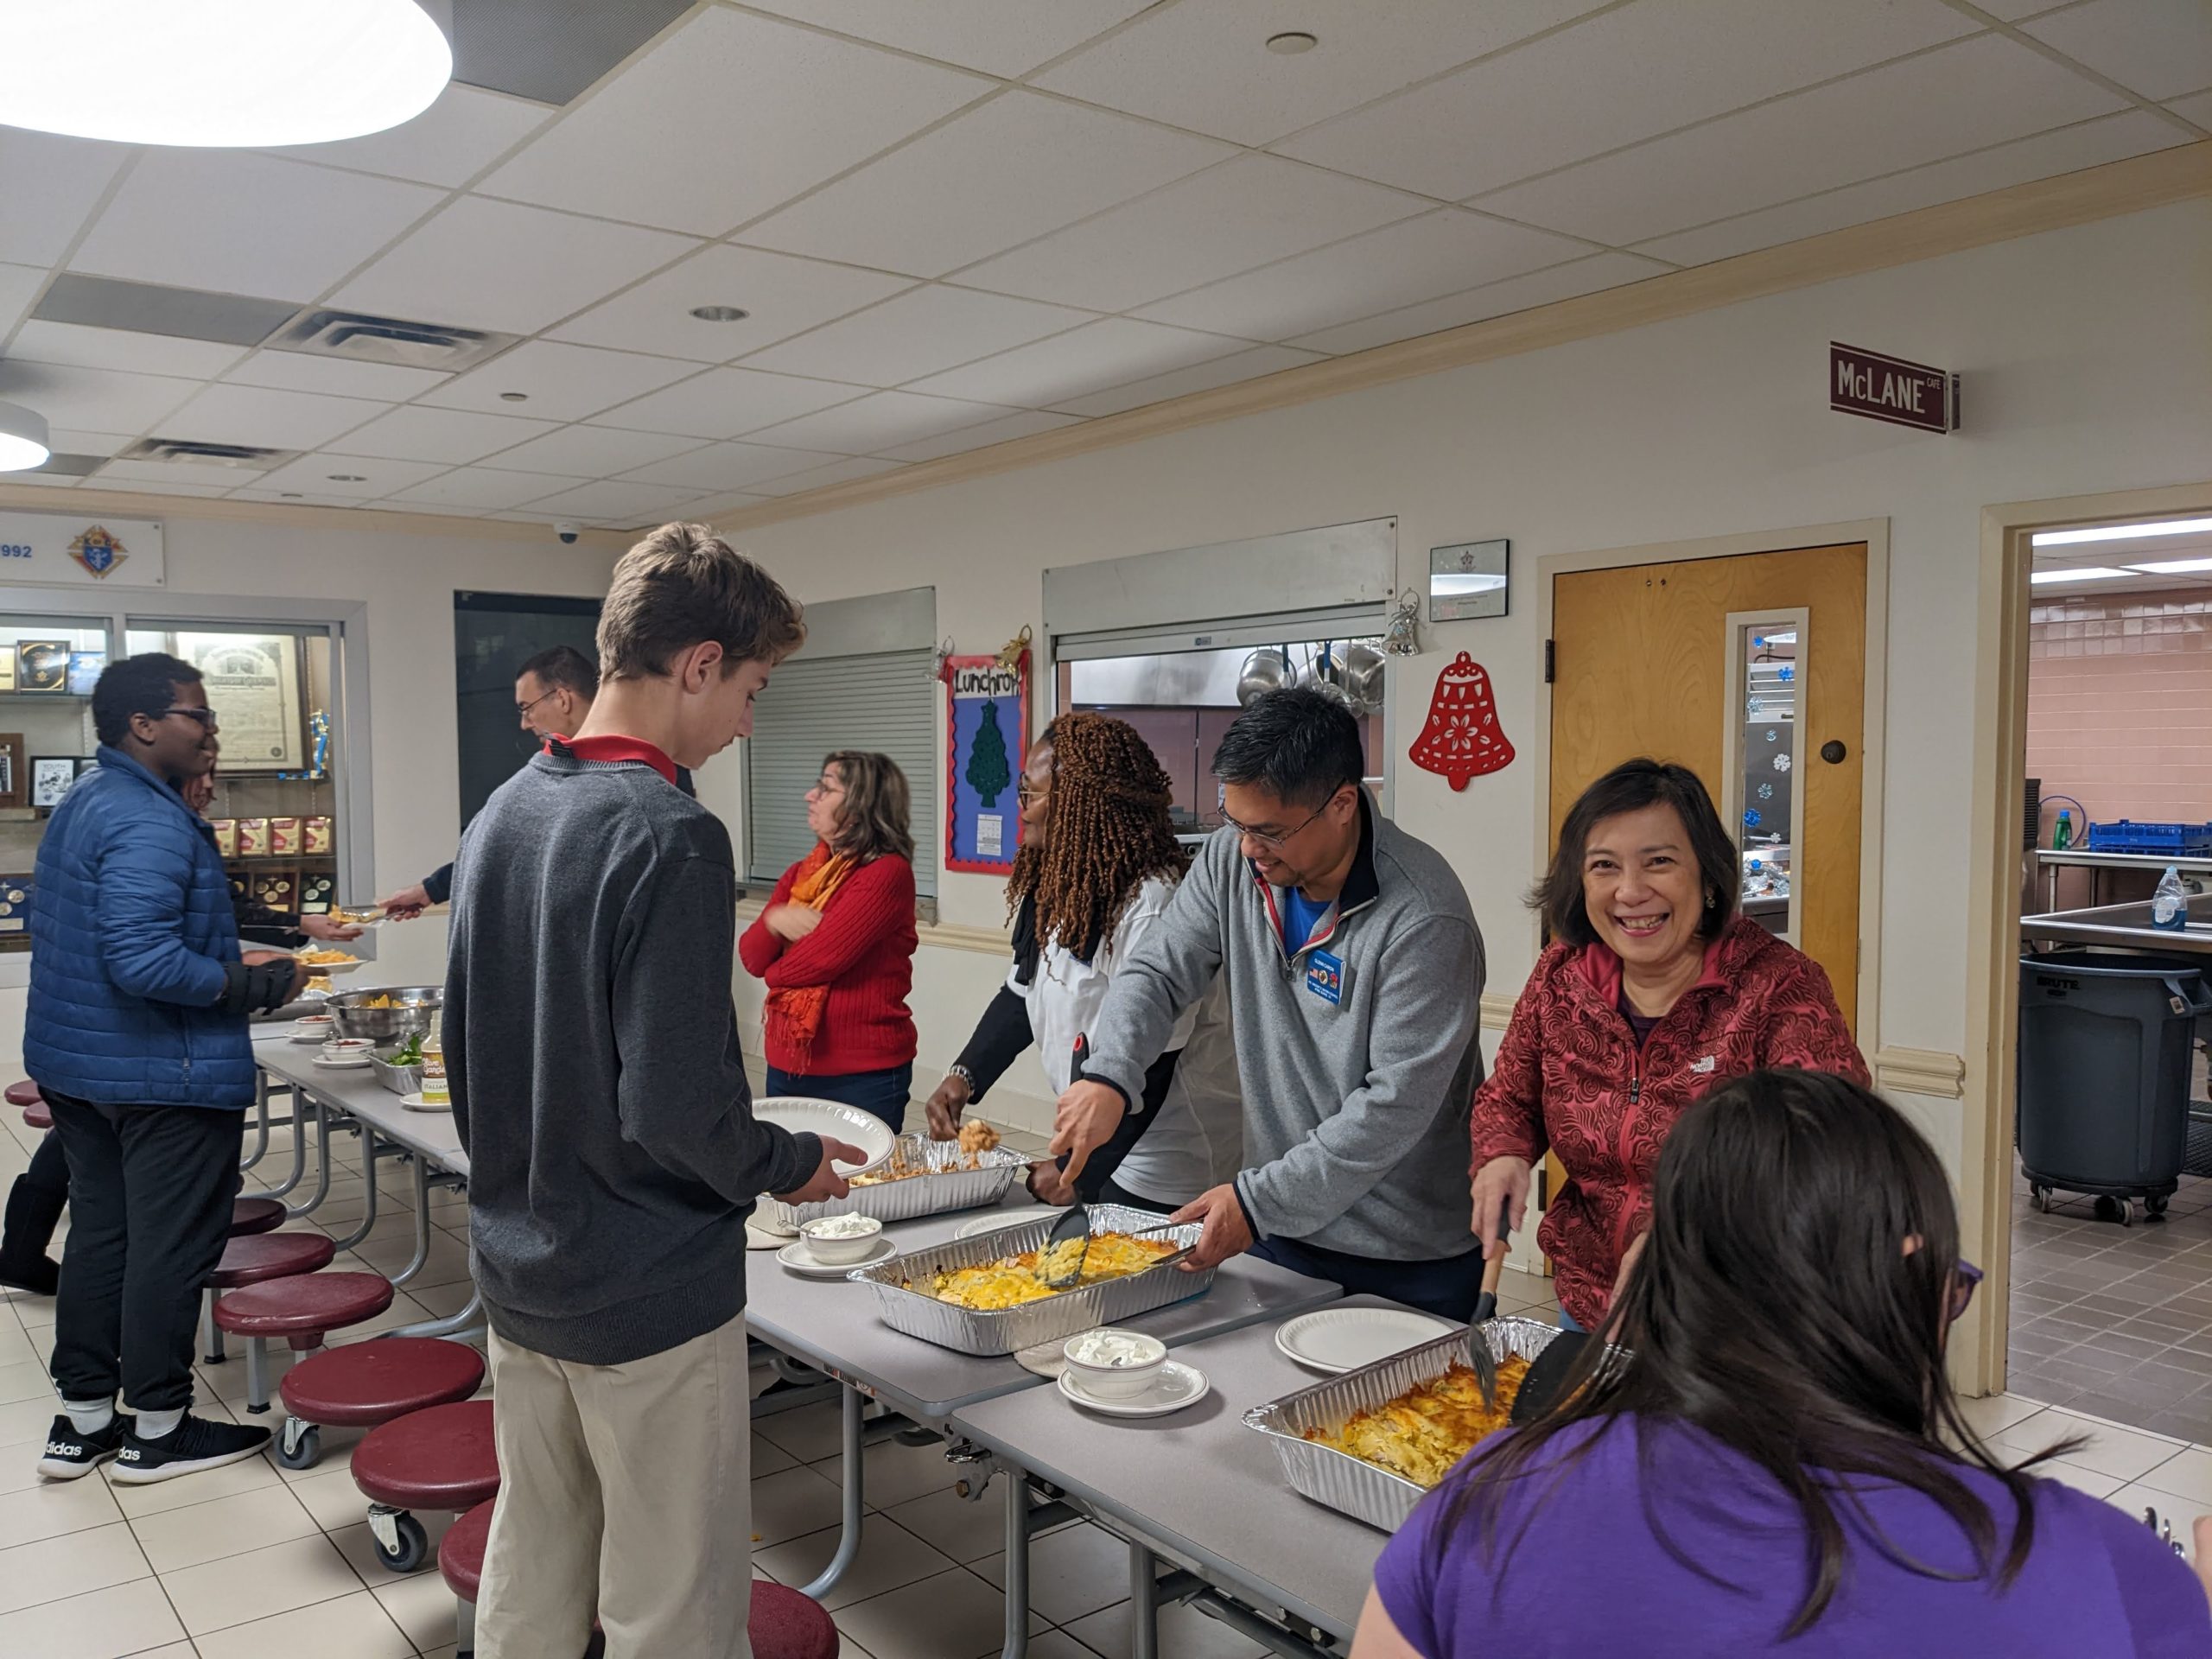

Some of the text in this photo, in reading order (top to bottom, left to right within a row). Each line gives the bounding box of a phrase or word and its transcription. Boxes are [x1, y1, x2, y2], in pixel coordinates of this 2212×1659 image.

[1838, 359, 1926, 415] McLANE
[1, 544, 33, 558] 992
[46, 1440, 83, 1457] didas
[118, 1446, 141, 1461] das
